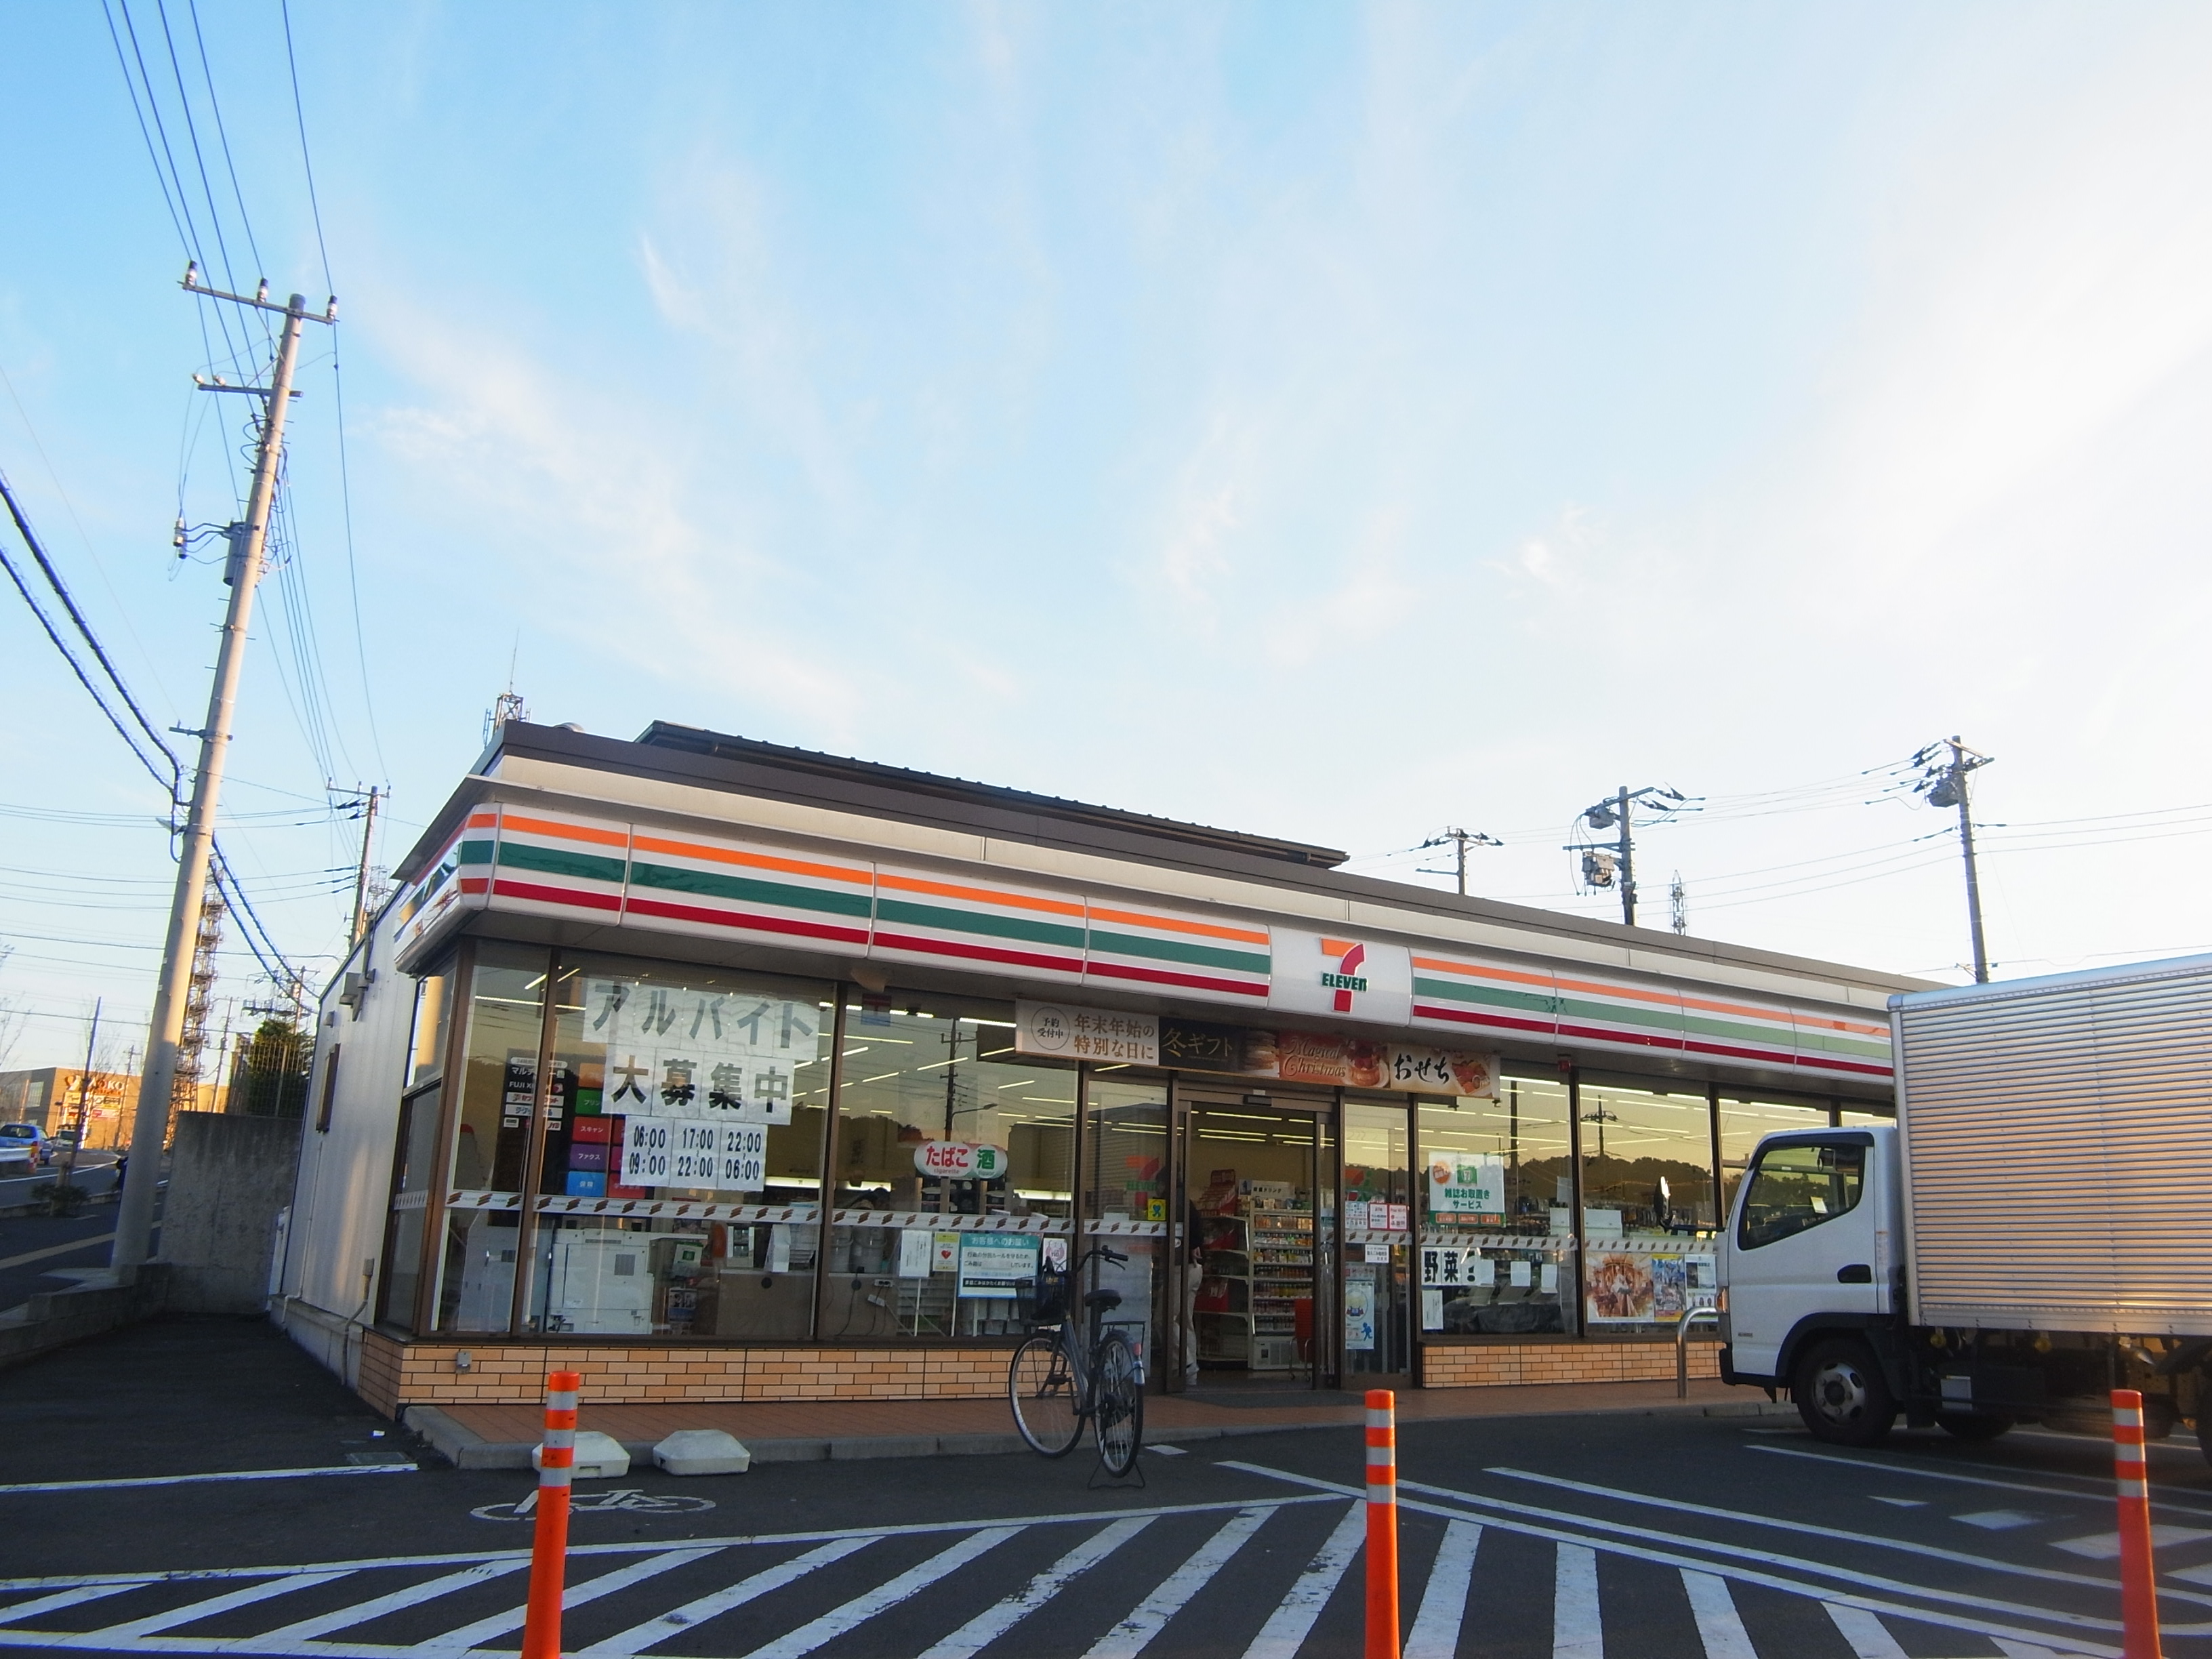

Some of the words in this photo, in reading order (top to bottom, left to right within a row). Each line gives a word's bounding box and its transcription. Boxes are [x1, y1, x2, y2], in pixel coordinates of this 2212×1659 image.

[1321, 939, 1365, 1012] 7
[592, 985, 813, 1048] アルバイト
[1042, 1017, 1060, 1027] 予約
[1074, 1014, 1155, 1038] 年末年始の
[1038, 1028, 1063, 1038] 受付中
[1162, 1027, 1233, 1057] 冬ギフト
[1073, 1035, 1154, 1059] 特別な日に
[1284, 1036, 1342, 1061] Magical
[1284, 1055, 1347, 1078] Christmas
[1394, 1052, 1450, 1084] おせち
[611, 1054, 789, 1113] 大募集中
[580, 1126, 604, 1134] スキャン
[633, 1125, 666, 1149] 06:00
[682, 1128, 714, 1150] 17:00
[726, 1131, 762, 1153] 22:00
[629, 1152, 666, 1176] 09:00
[678, 1155, 714, 1178] 22:00
[926, 1146, 968, 1168] たばこ
[977, 1149, 996, 1170] 酒
[725, 1159, 760, 1181] 06:00
[1444, 1188, 1490, 1200] 雑誌お取置き
[1452, 1200, 1482, 1209] サービス
[971, 1237, 1029, 1246] お客様へのお願い
